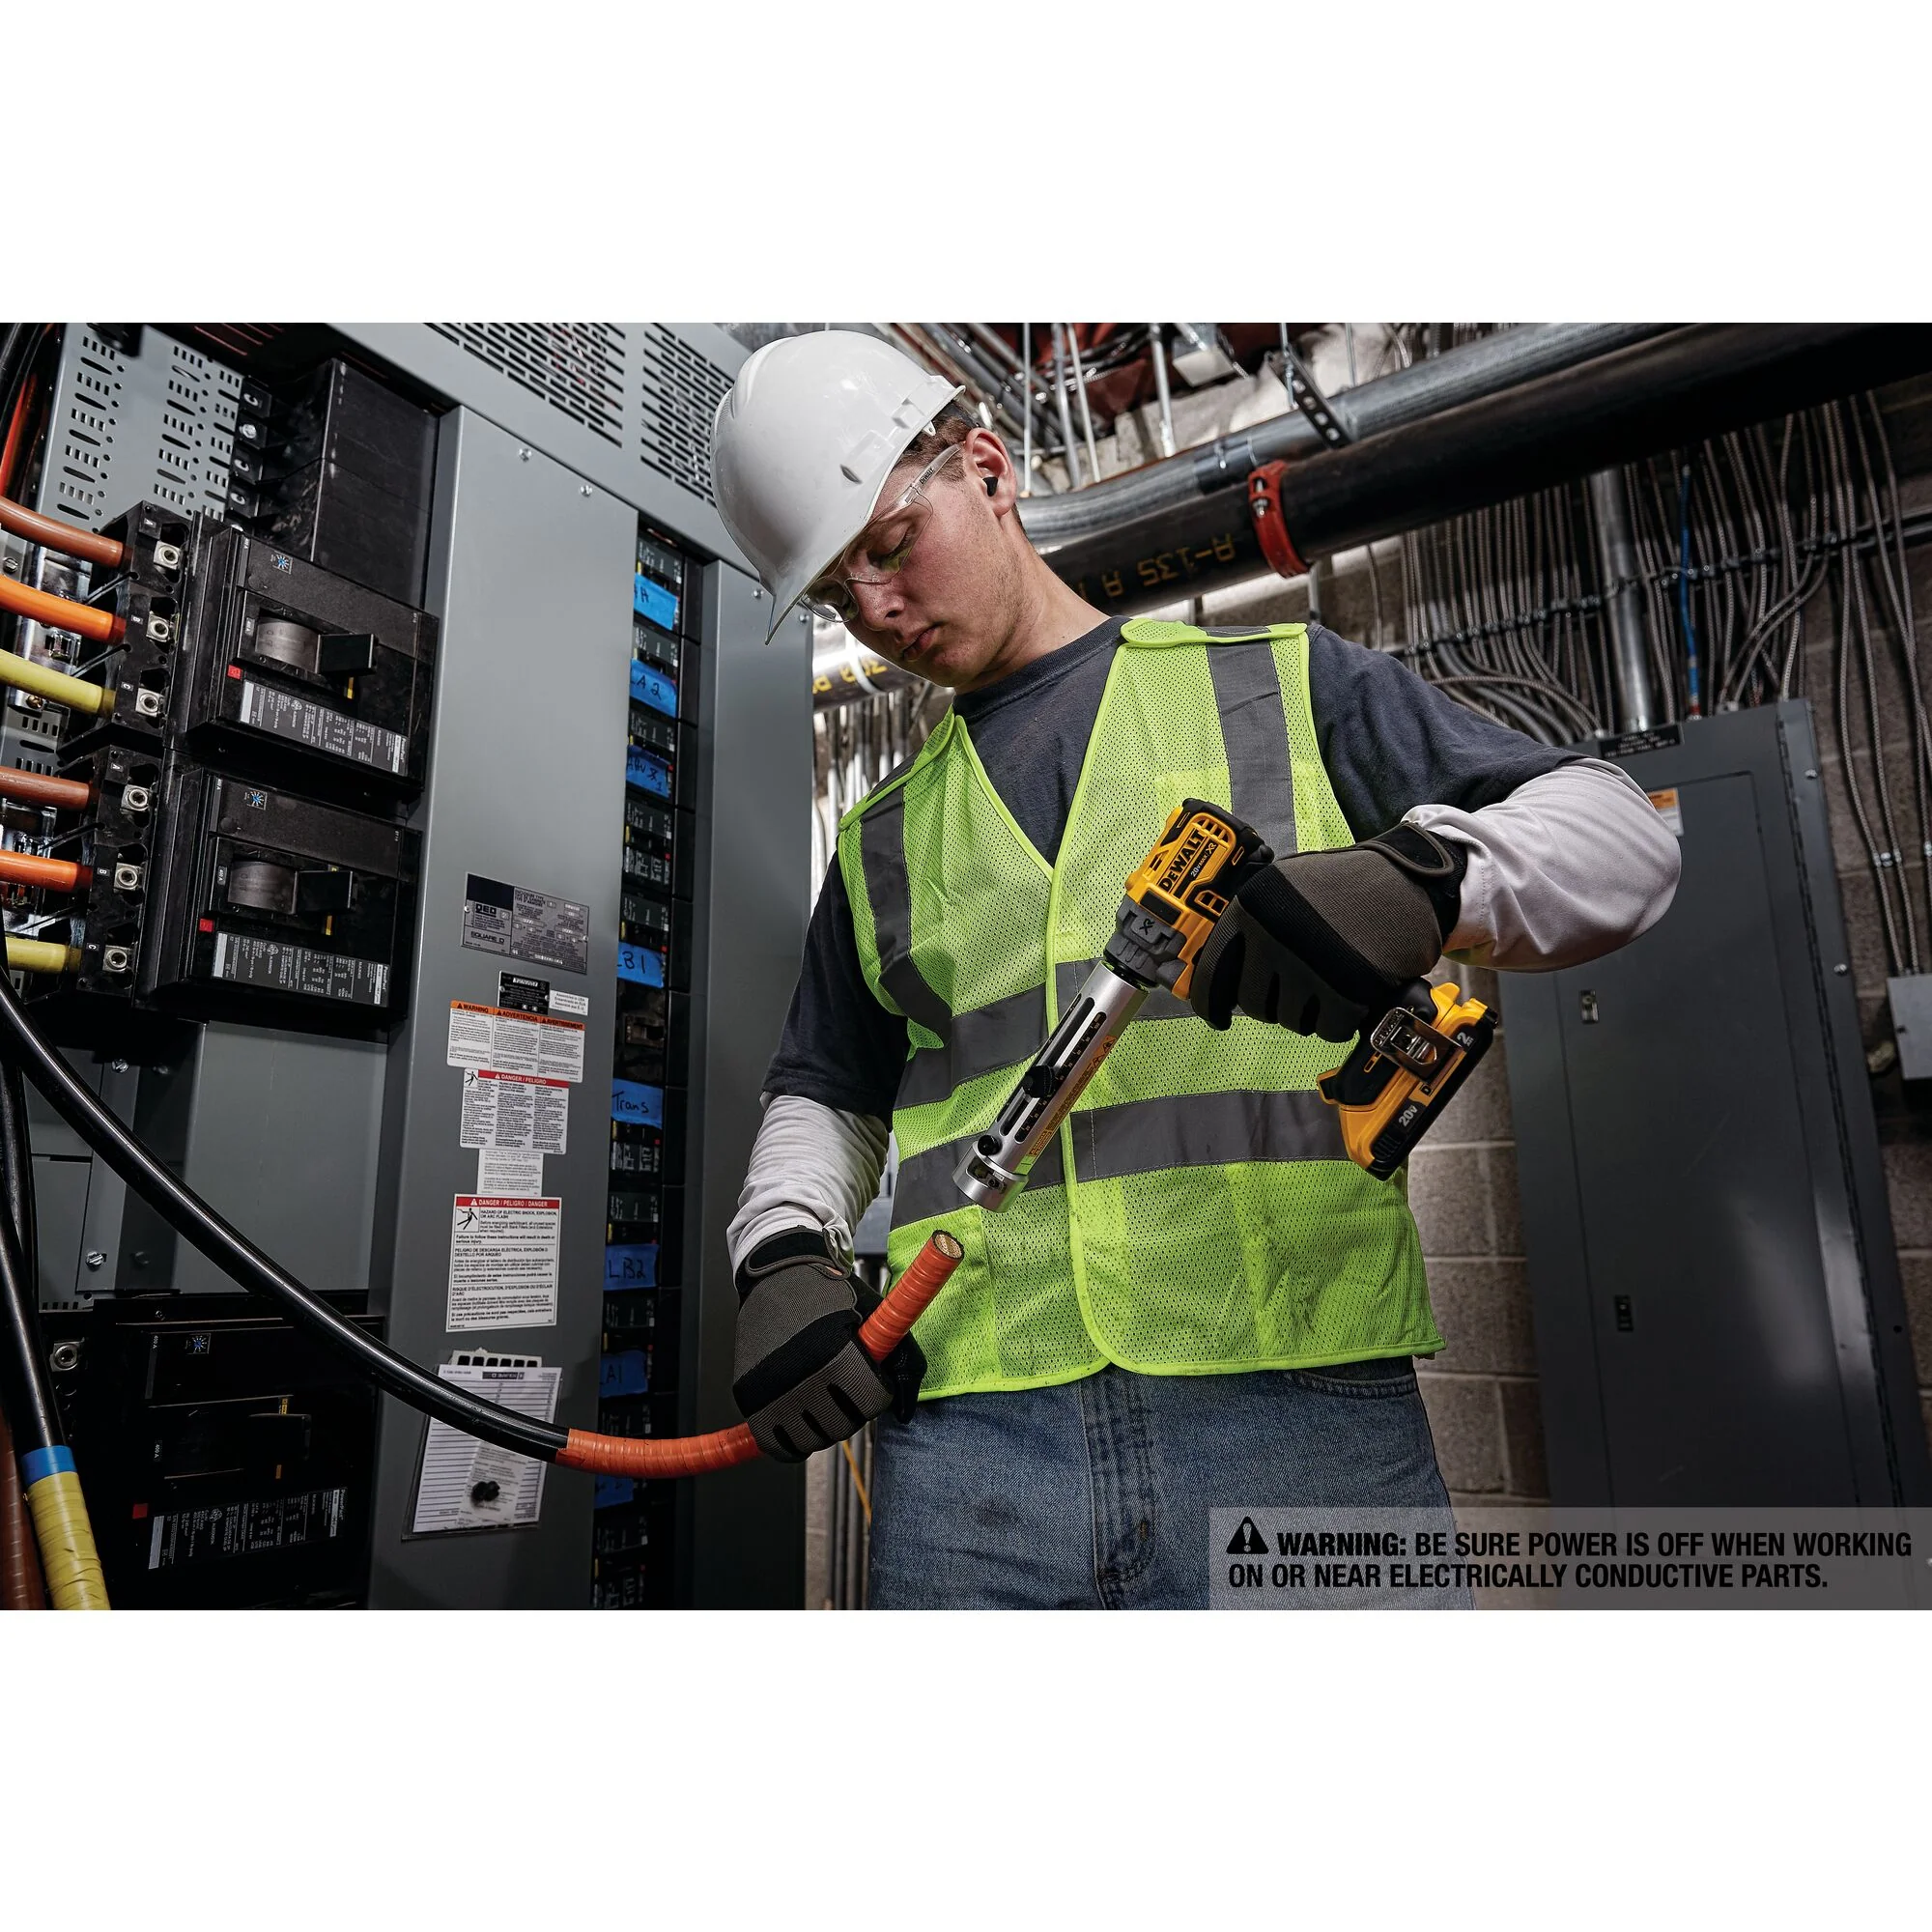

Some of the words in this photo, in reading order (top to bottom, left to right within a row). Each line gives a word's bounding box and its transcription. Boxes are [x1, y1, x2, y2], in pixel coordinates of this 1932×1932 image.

[1159, 828, 1207, 893] DEWALT
[1139, 918, 1155, 936] XR
[463, 1004, 489, 1013] WARNING
[501, 1010, 539, 1022] ADVERTENCIA
[500, 1073, 523, 1082] DANGER
[611, 1093, 650, 1114] Trans
